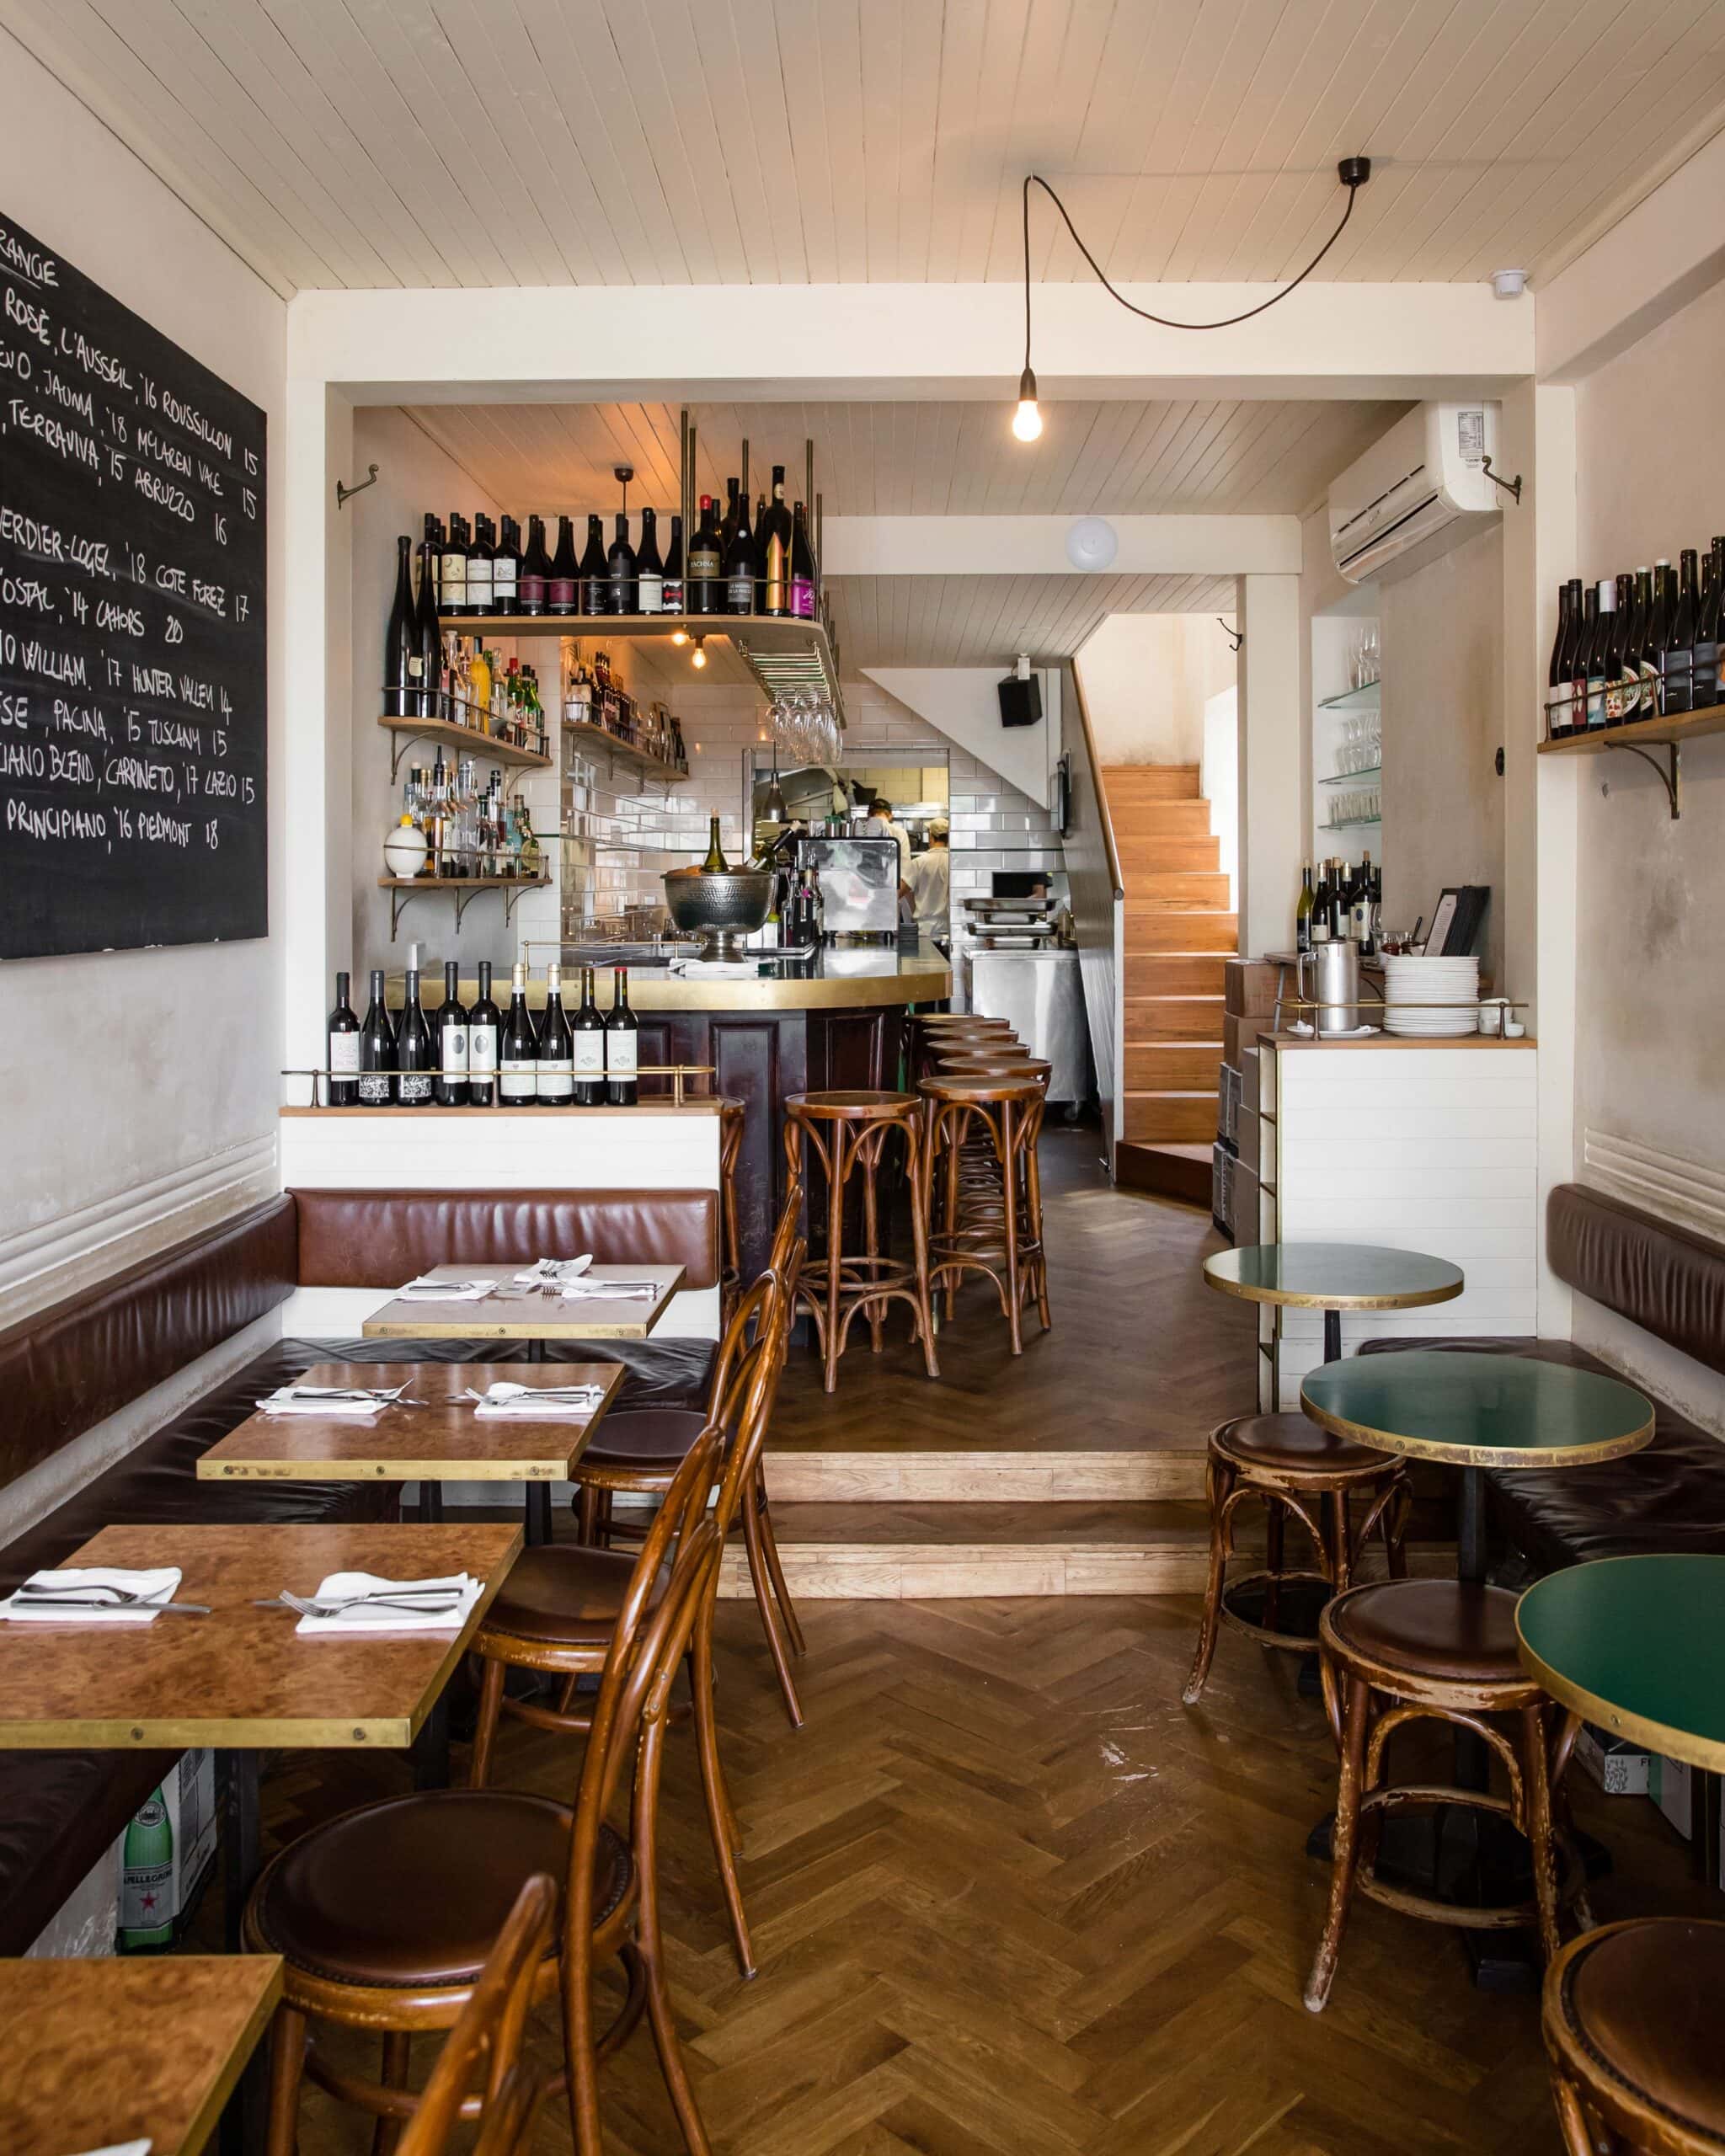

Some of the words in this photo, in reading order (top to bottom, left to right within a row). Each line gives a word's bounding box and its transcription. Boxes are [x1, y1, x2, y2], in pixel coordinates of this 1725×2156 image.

[163, 391, 232, 460] ROUSSILLON
[244, 447, 259, 475] 15
[134, 467, 195, 522] ABRUZZO
[215, 512, 227, 546] 16
[243, 487, 257, 520] 15
[95, 599, 146, 638] CAHORS
[164, 615, 184, 643] 20
[235, 595, 250, 622] 17
[131, 663, 177, 699] HUNTER
[179, 674, 214, 712] VALLEY
[220, 685, 233, 727] 14
[147, 719, 202, 756] TUSCANY
[212, 729, 228, 757] 15
[204, 770, 237, 798] LAZIO
[241, 776, 255, 804] 15
[137, 812, 193, 848] PIEDMONT
[205, 818, 219, 850] 18
